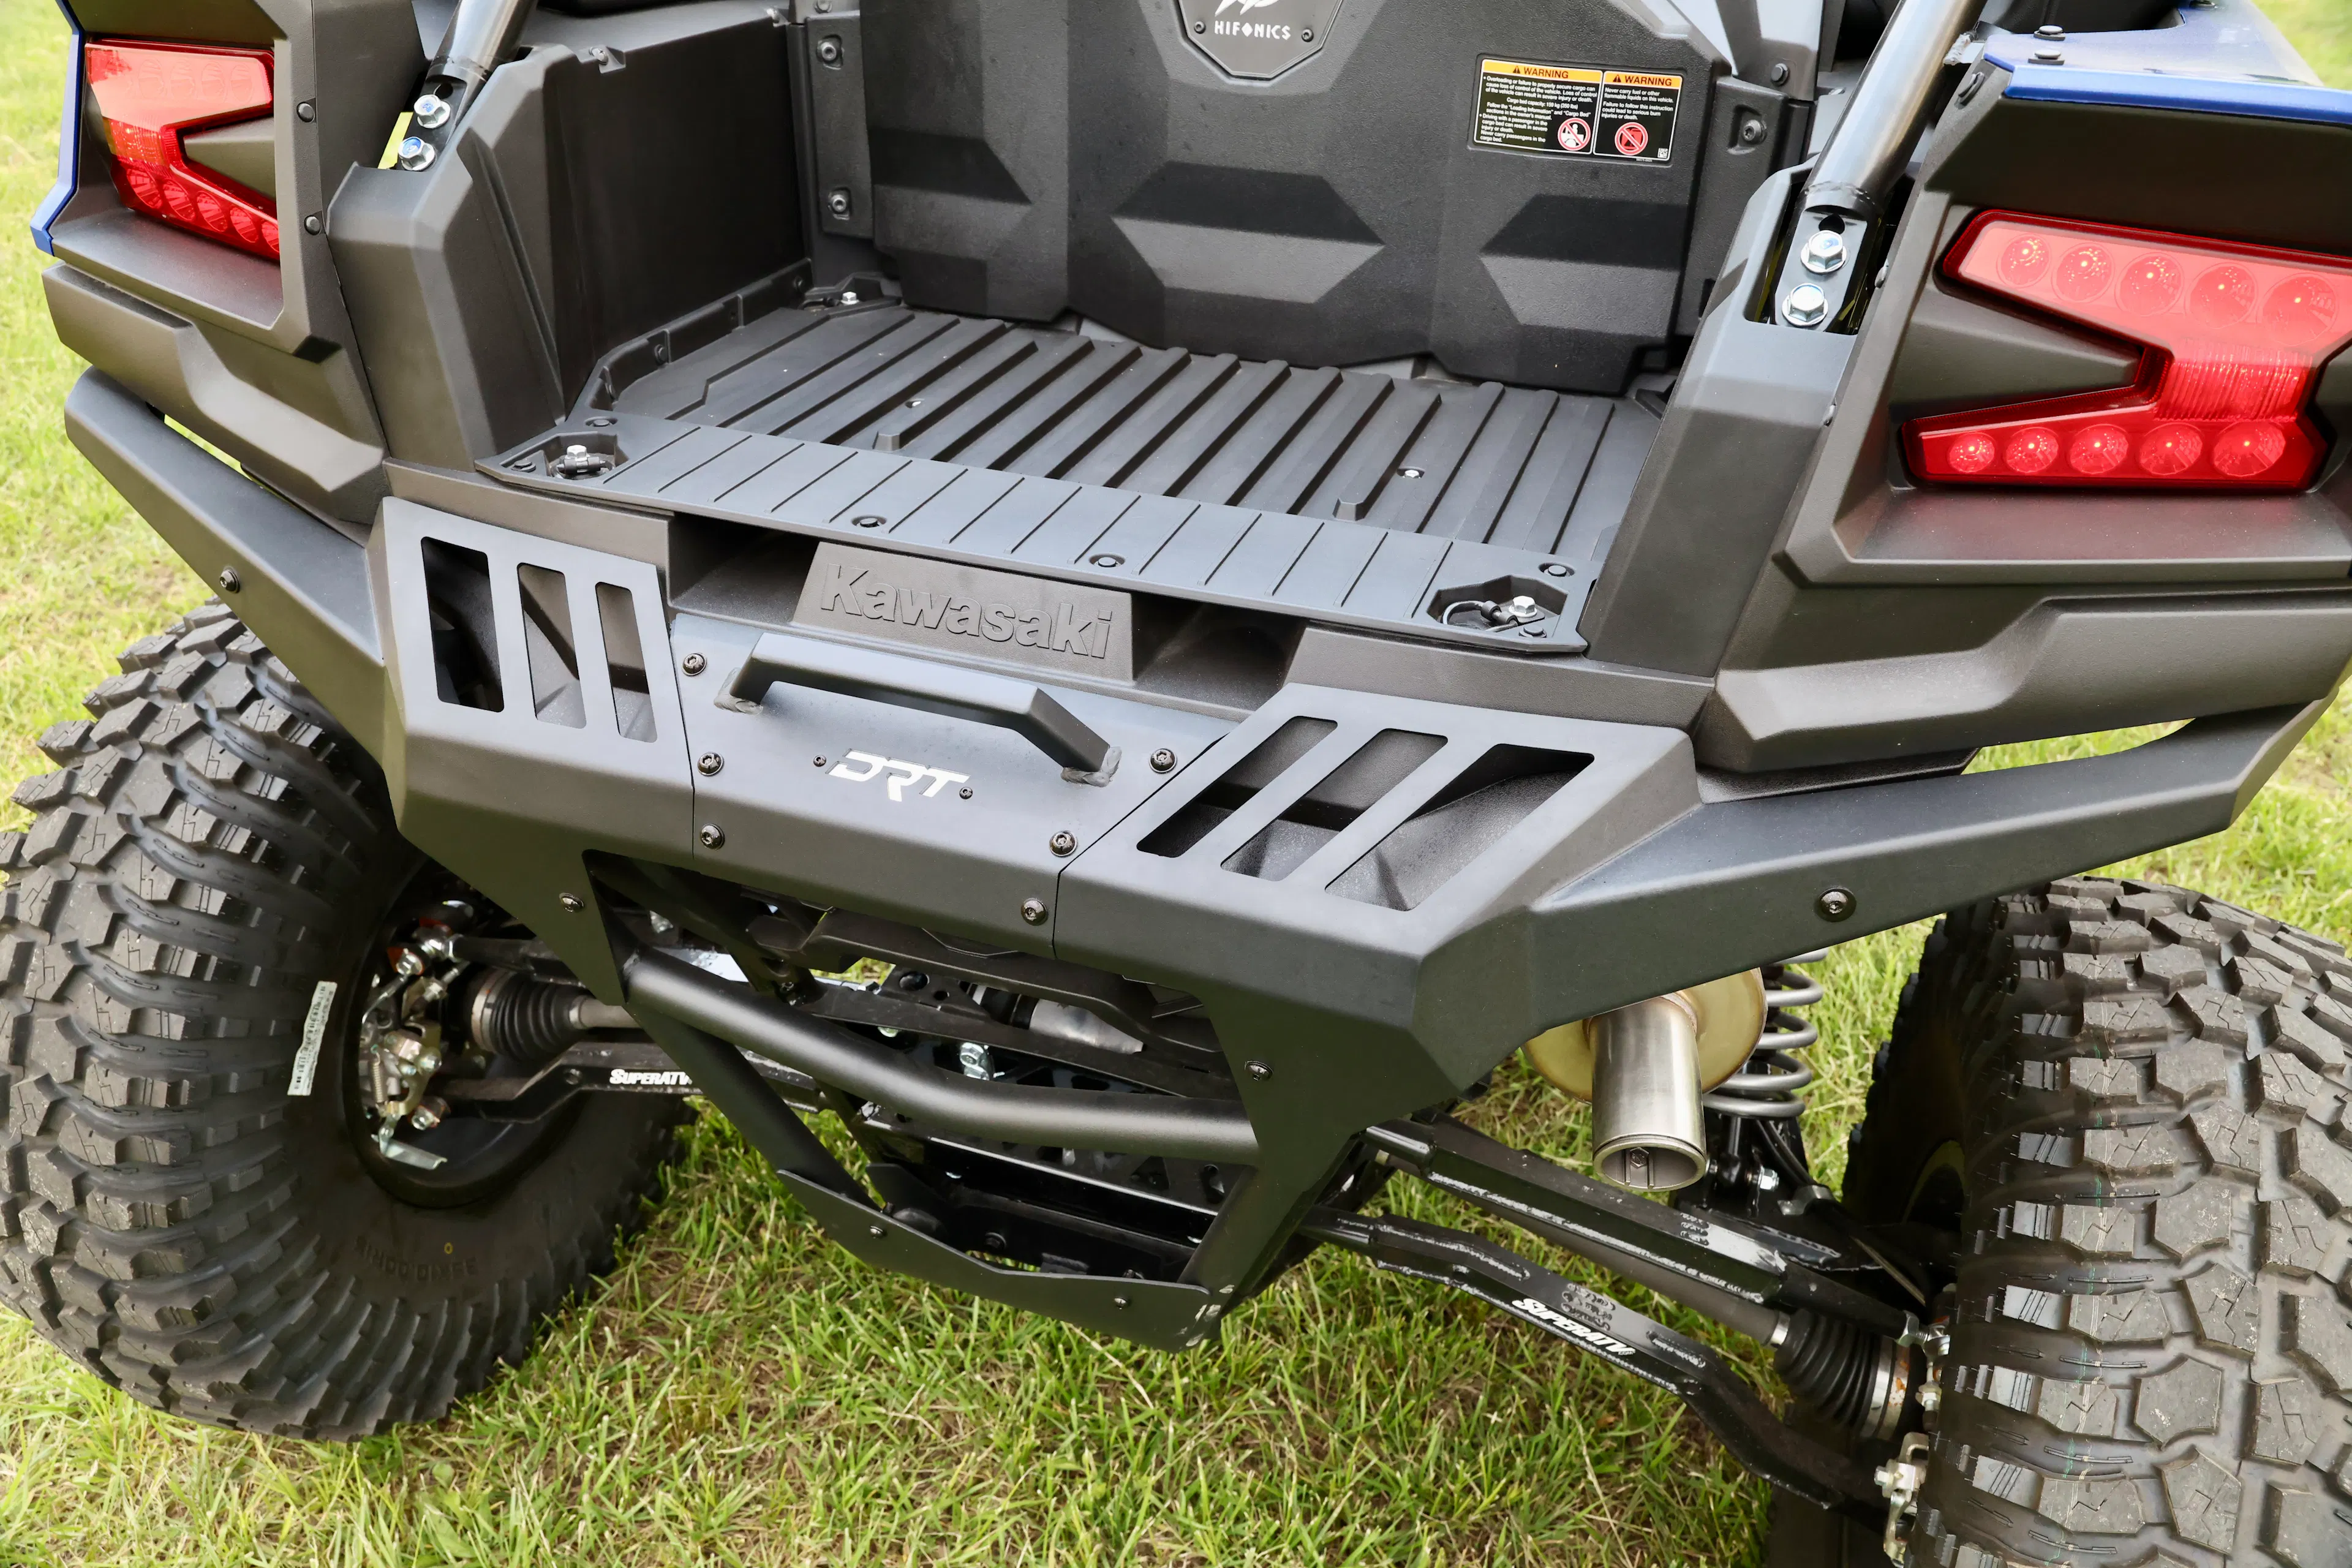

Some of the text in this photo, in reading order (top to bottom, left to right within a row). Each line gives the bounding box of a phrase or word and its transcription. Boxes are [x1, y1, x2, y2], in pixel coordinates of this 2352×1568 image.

[1215, 20, 1291, 40] HIFONICS
[1487, 75, 1512, 85] Overloading
[1524, 67, 1568, 78] WARNING
[1625, 76, 1672, 86] WARNING
[821, 564, 1113, 659] Kawasaki
[826, 748, 971, 802] DRT
